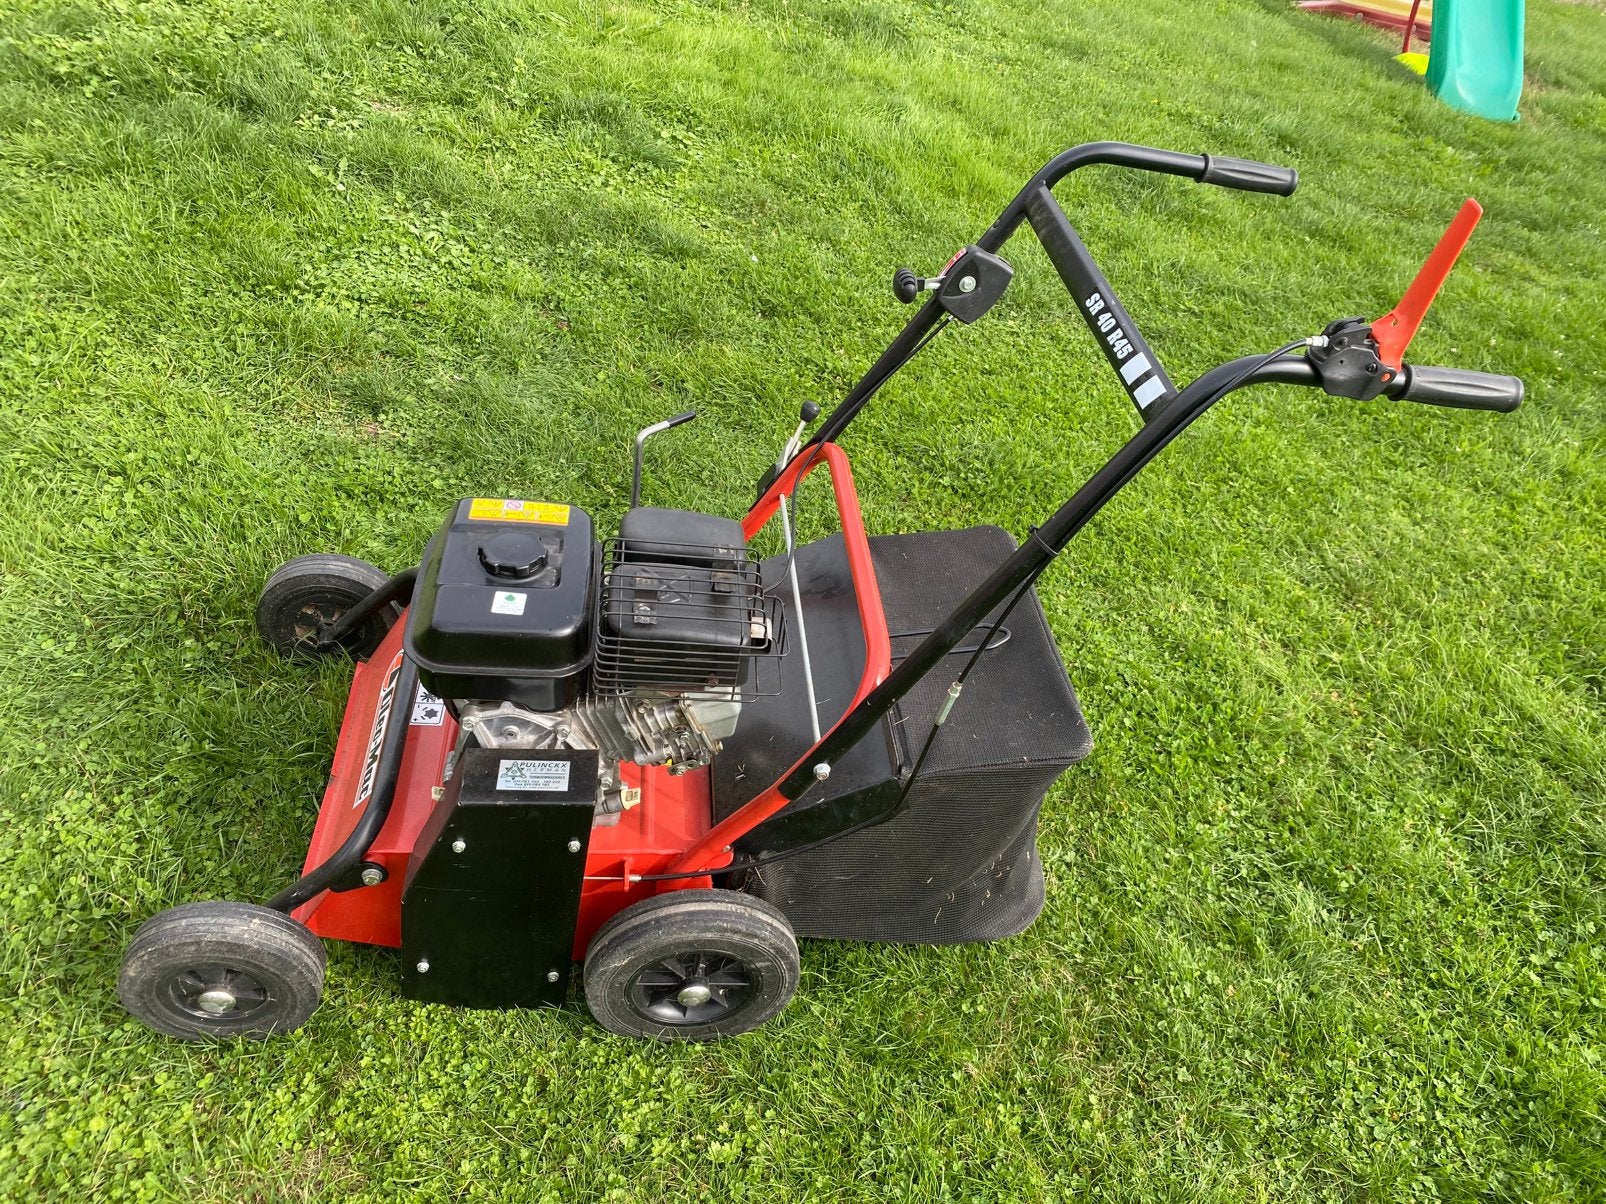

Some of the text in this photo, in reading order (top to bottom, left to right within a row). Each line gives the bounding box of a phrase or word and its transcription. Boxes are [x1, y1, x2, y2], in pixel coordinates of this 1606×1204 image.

[1085, 292, 1134, 359] SR 40 R45
